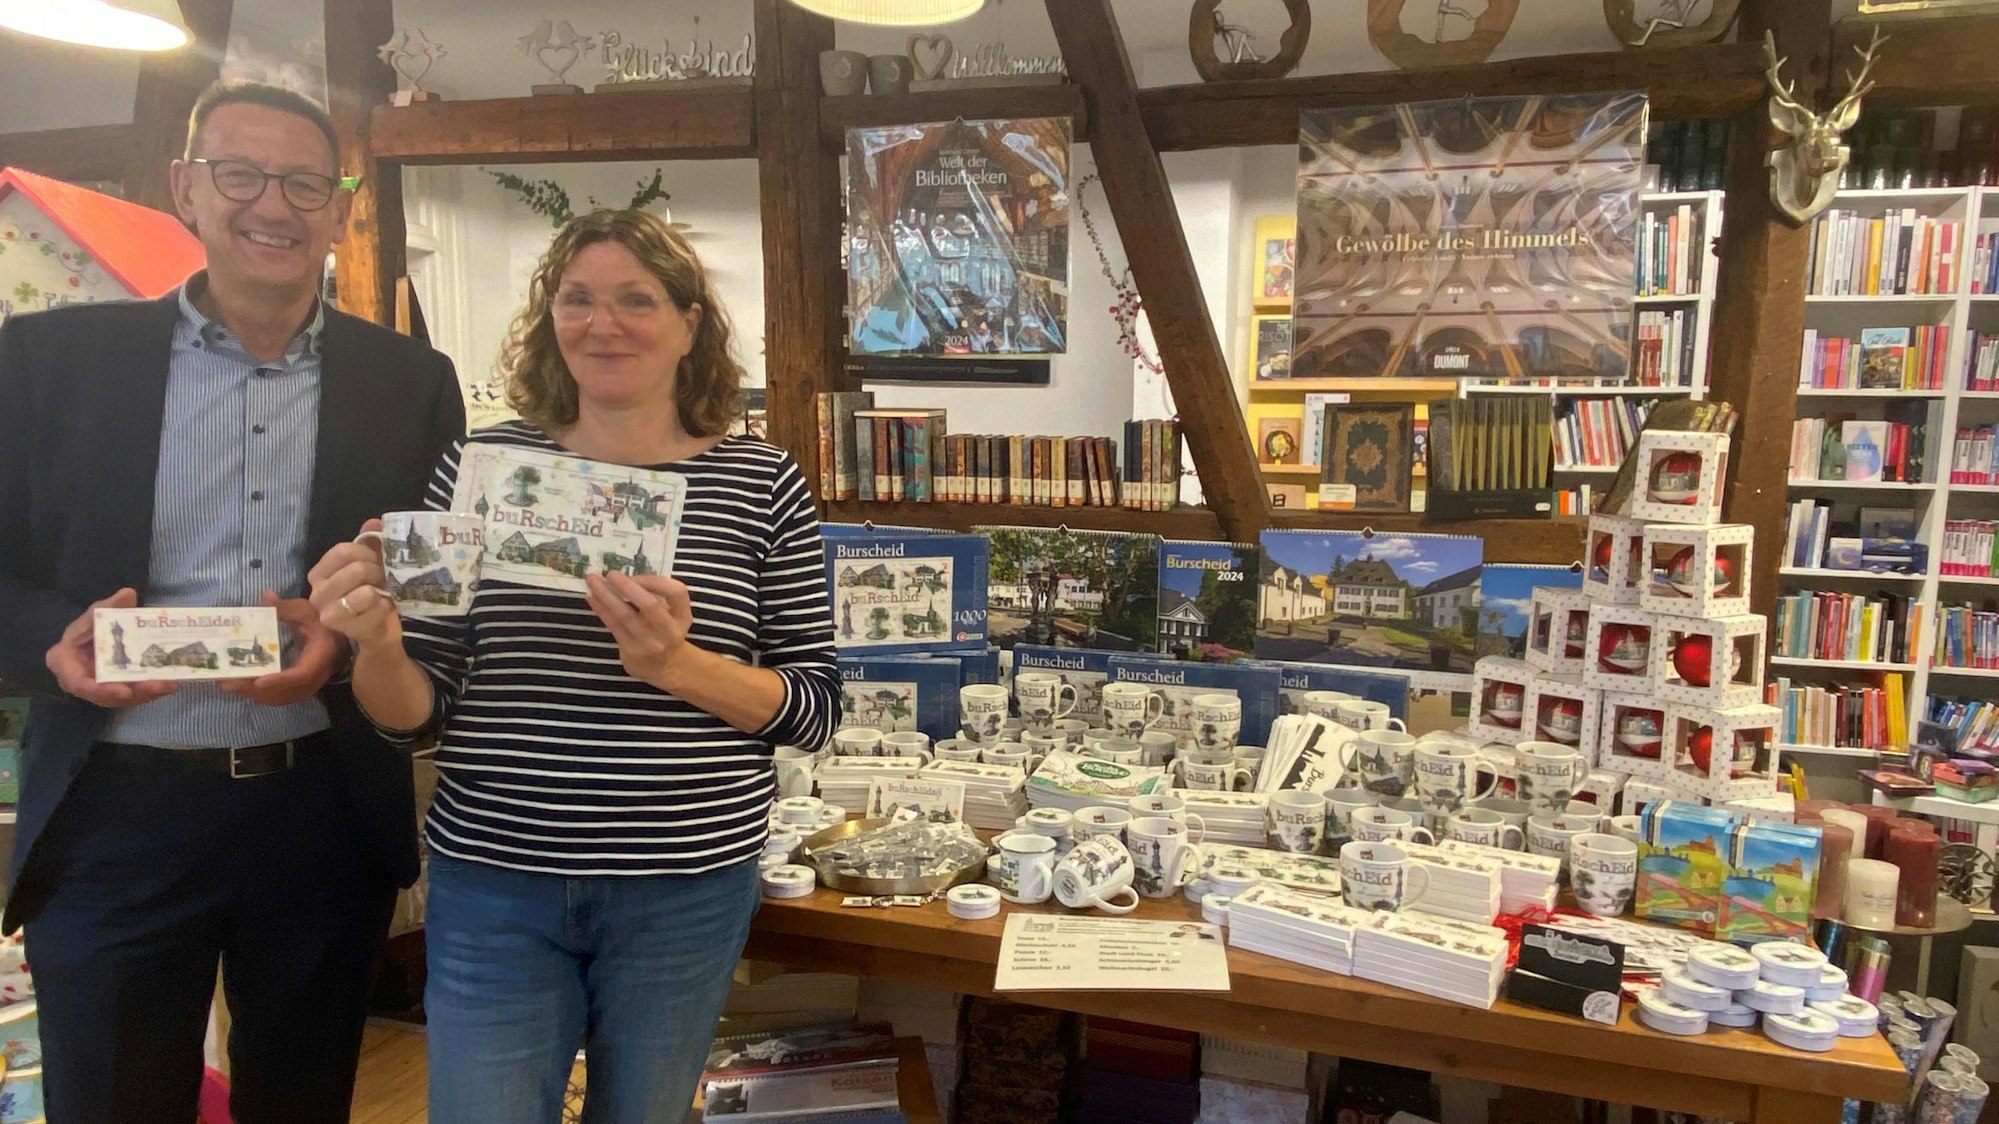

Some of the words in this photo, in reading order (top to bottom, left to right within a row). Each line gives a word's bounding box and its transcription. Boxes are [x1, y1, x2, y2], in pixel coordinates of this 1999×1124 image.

[939, 155, 965, 168] Welt
[967, 155, 989, 168] der
[915, 169, 1008, 187] Bibliotheken
[1335, 232, 1430, 254] Gewölbe
[1437, 230, 1476, 252] des
[1483, 226, 1590, 250] Himmels
[944, 335, 969, 347] 2024
[1434, 354, 1470, 369] DUMONT
[492, 503, 604, 539] buRschEid
[836, 542, 905, 558] Burscheid
[1166, 554, 1232, 570] Burscheid
[1216, 570, 1244, 582] 2024
[953, 609, 987, 622] 1000
[1020, 653, 1085, 670] Burscheid
[1116, 667, 1185, 685] Burscheid
